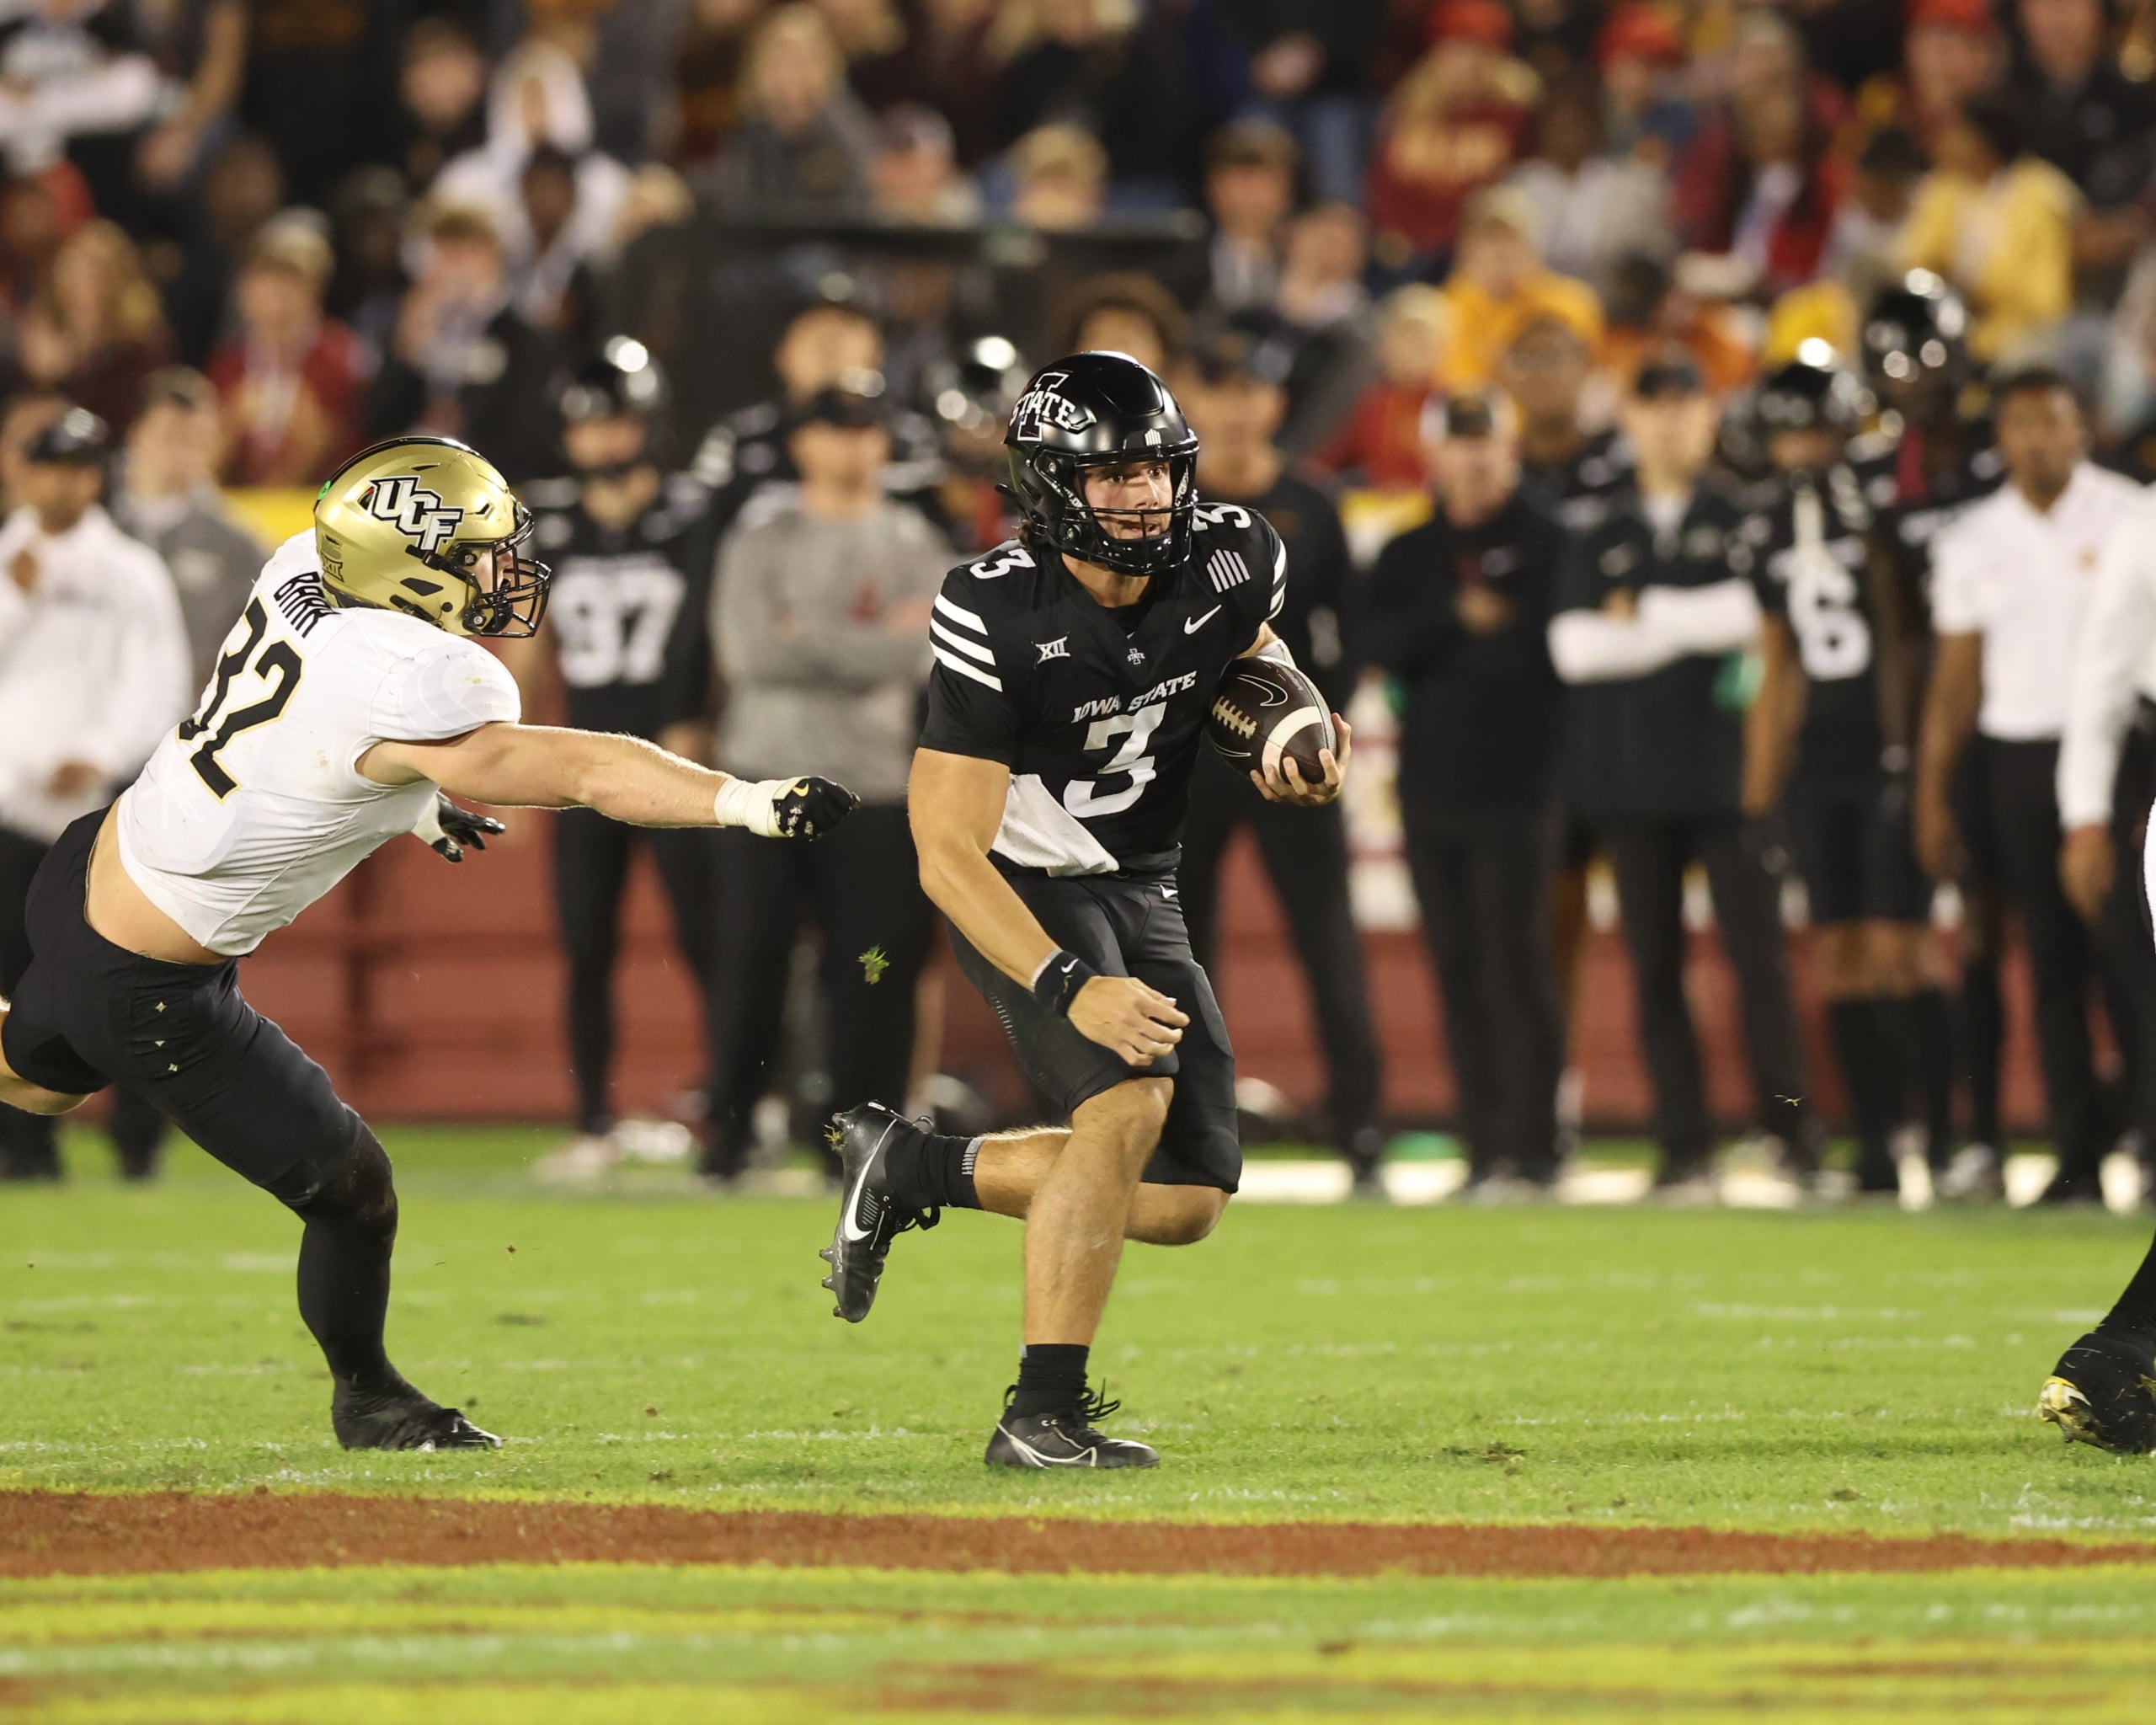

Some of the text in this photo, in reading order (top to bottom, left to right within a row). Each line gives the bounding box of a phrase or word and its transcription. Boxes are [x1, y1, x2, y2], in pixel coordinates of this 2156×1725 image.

[1009, 391, 1076, 430] STATE
[370, 475, 465, 554] UCF
[1192, 505, 1251, 531] 3
[969, 547, 1037, 579] 3
[548, 552, 688, 688] 97
[1034, 635, 1071, 665] XII
[1785, 559, 1873, 682] 6
[175, 591, 307, 805] 32
[1070, 670, 1198, 724] IOWA STATE
[1063, 701, 1168, 819] 3
